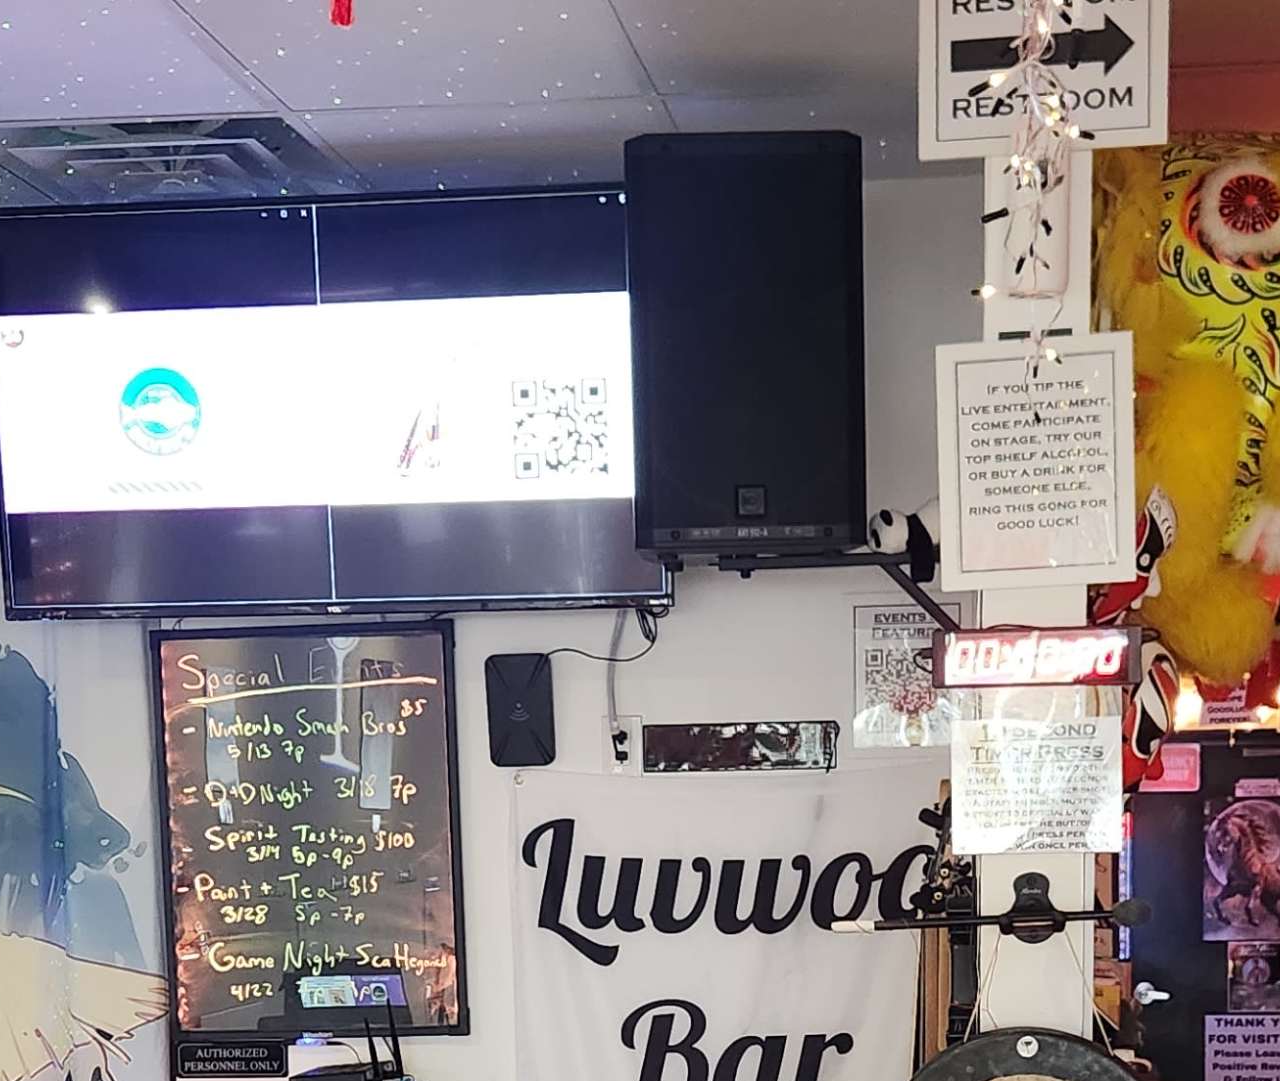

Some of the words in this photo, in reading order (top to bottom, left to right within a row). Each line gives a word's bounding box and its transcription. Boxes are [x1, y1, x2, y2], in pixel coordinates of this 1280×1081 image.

[1003, 382, 1029, 393] YOU
[1033, 381, 1054, 392] TIP
[1058, 380, 1084, 391] THE
[961, 404, 990, 416] LIVE
[971, 420, 1010, 432] COME
[971, 438, 991, 449] ON
[1045, 433, 1070, 444] TRY
[1073, 431, 1102, 442] OUR
[965, 454, 992, 465] TOP
[995, 451, 1038, 463] SHELF
[968, 470, 988, 481] OR
[991, 468, 1018, 480] BUY
[1020, 468, 1031, 478] A
[1079, 463, 1106, 475] FOR
[968, 505, 1002, 516] RING
[1005, 502, 1035, 513] THIS
[1037, 500, 1078, 512] GONG
[1080, 499, 1108, 509] FOR
[997, 518, 1035, 531] GOOD
[1039, 513, 1080, 528] LUCK!
[177, 653, 286, 698] Special
[208, 714, 284, 738] Nintendo
[361, 711, 408, 736] Bros
[259, 784, 313, 813] Night
[390, 776, 418, 808] 7p
[204, 825, 279, 853] Spirit
[278, 872, 338, 902] Tea
[220, 905, 269, 924] 3/28
[208, 942, 275, 973] Game
[282, 942, 350, 976] Night
[1215, 1018, 1266, 1027] THANK
[1208, 1034, 1237, 1044] FOR
[196, 1048, 268, 1058] AUTHORIZED
[1214, 1049, 1252, 1057] Please
[184, 1061, 249, 1072] PERSONNEL
[250, 1060, 280, 1071] ONLY
[1212, 1062, 1257, 1071] Positive
